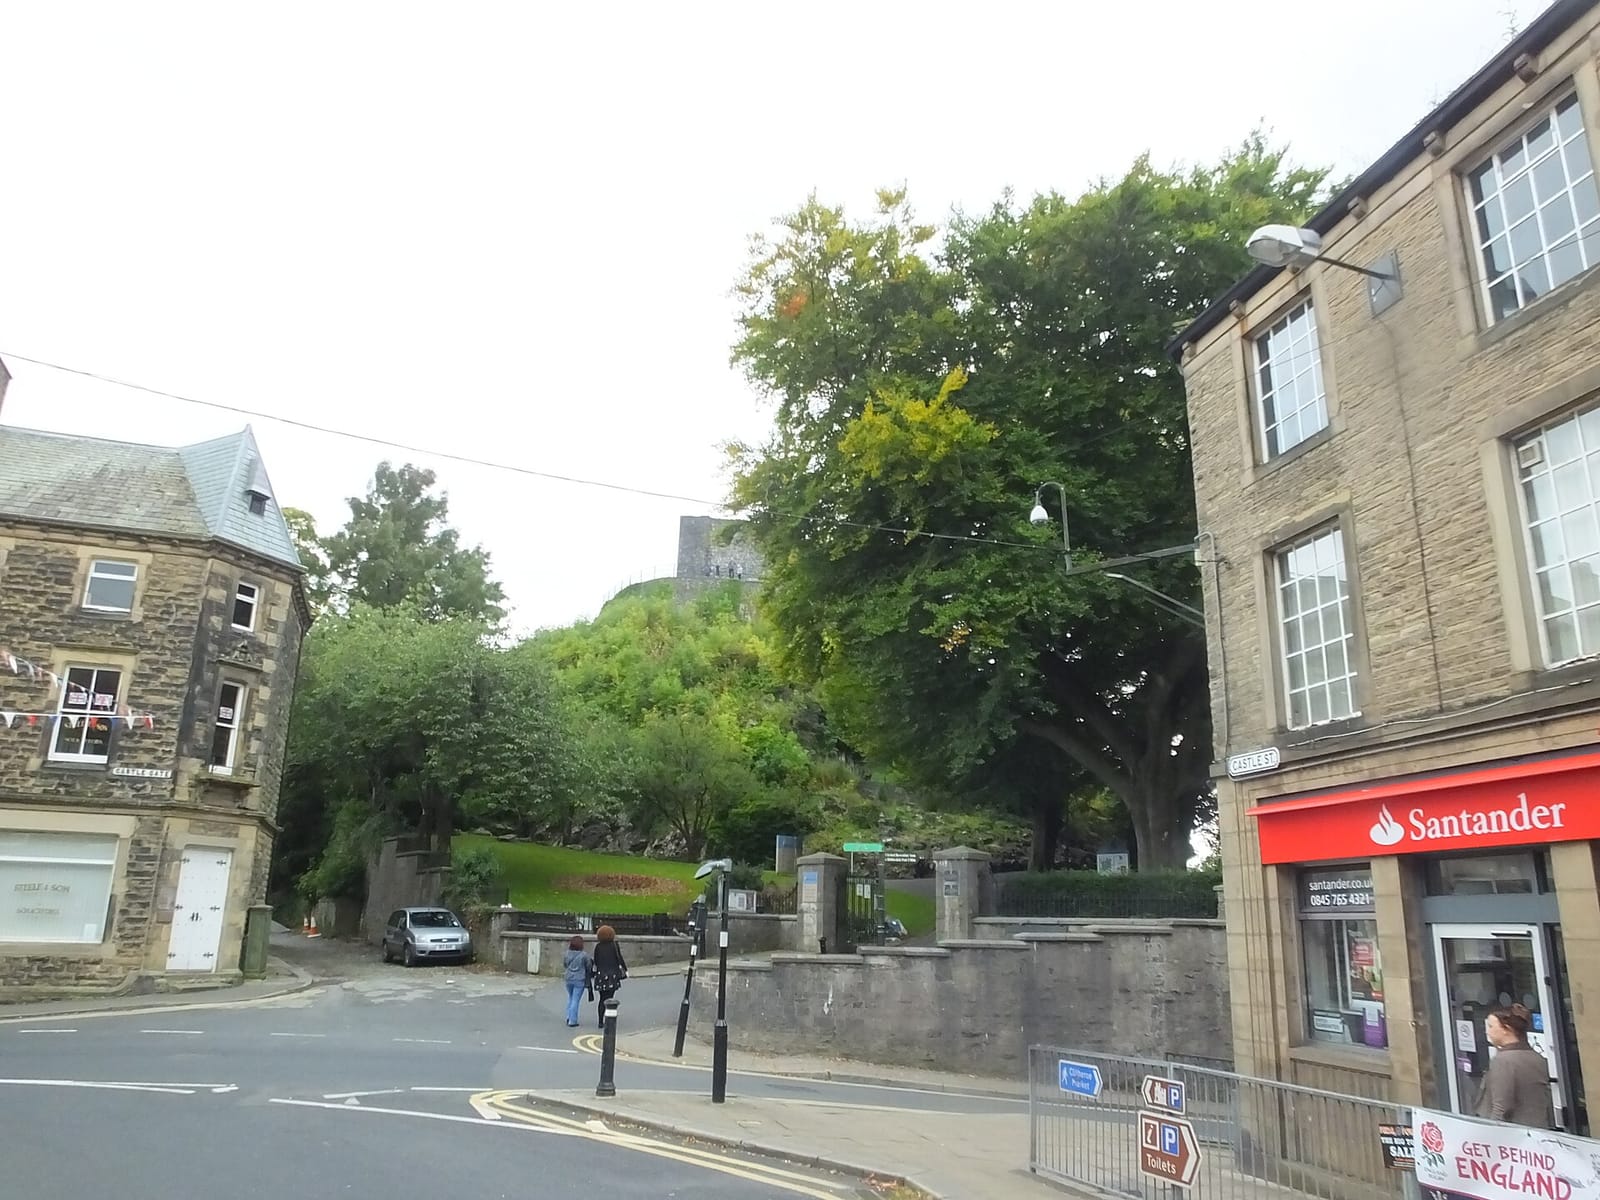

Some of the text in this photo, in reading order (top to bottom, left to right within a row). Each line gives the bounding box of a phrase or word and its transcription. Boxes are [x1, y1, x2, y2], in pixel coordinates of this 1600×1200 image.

[1233, 752, 1274, 771] CASTLE ST
[1408, 792, 1566, 841] Santander
[1310, 892, 1371, 906] 0845 765 4321
[1170, 1088, 1180, 1106] P
[1164, 1127, 1176, 1151] P
[1146, 1153, 1177, 1175] Toilets
[1462, 1141, 1555, 1171] GET BEHIND
[1455, 1156, 1572, 1200] ENGLAND
